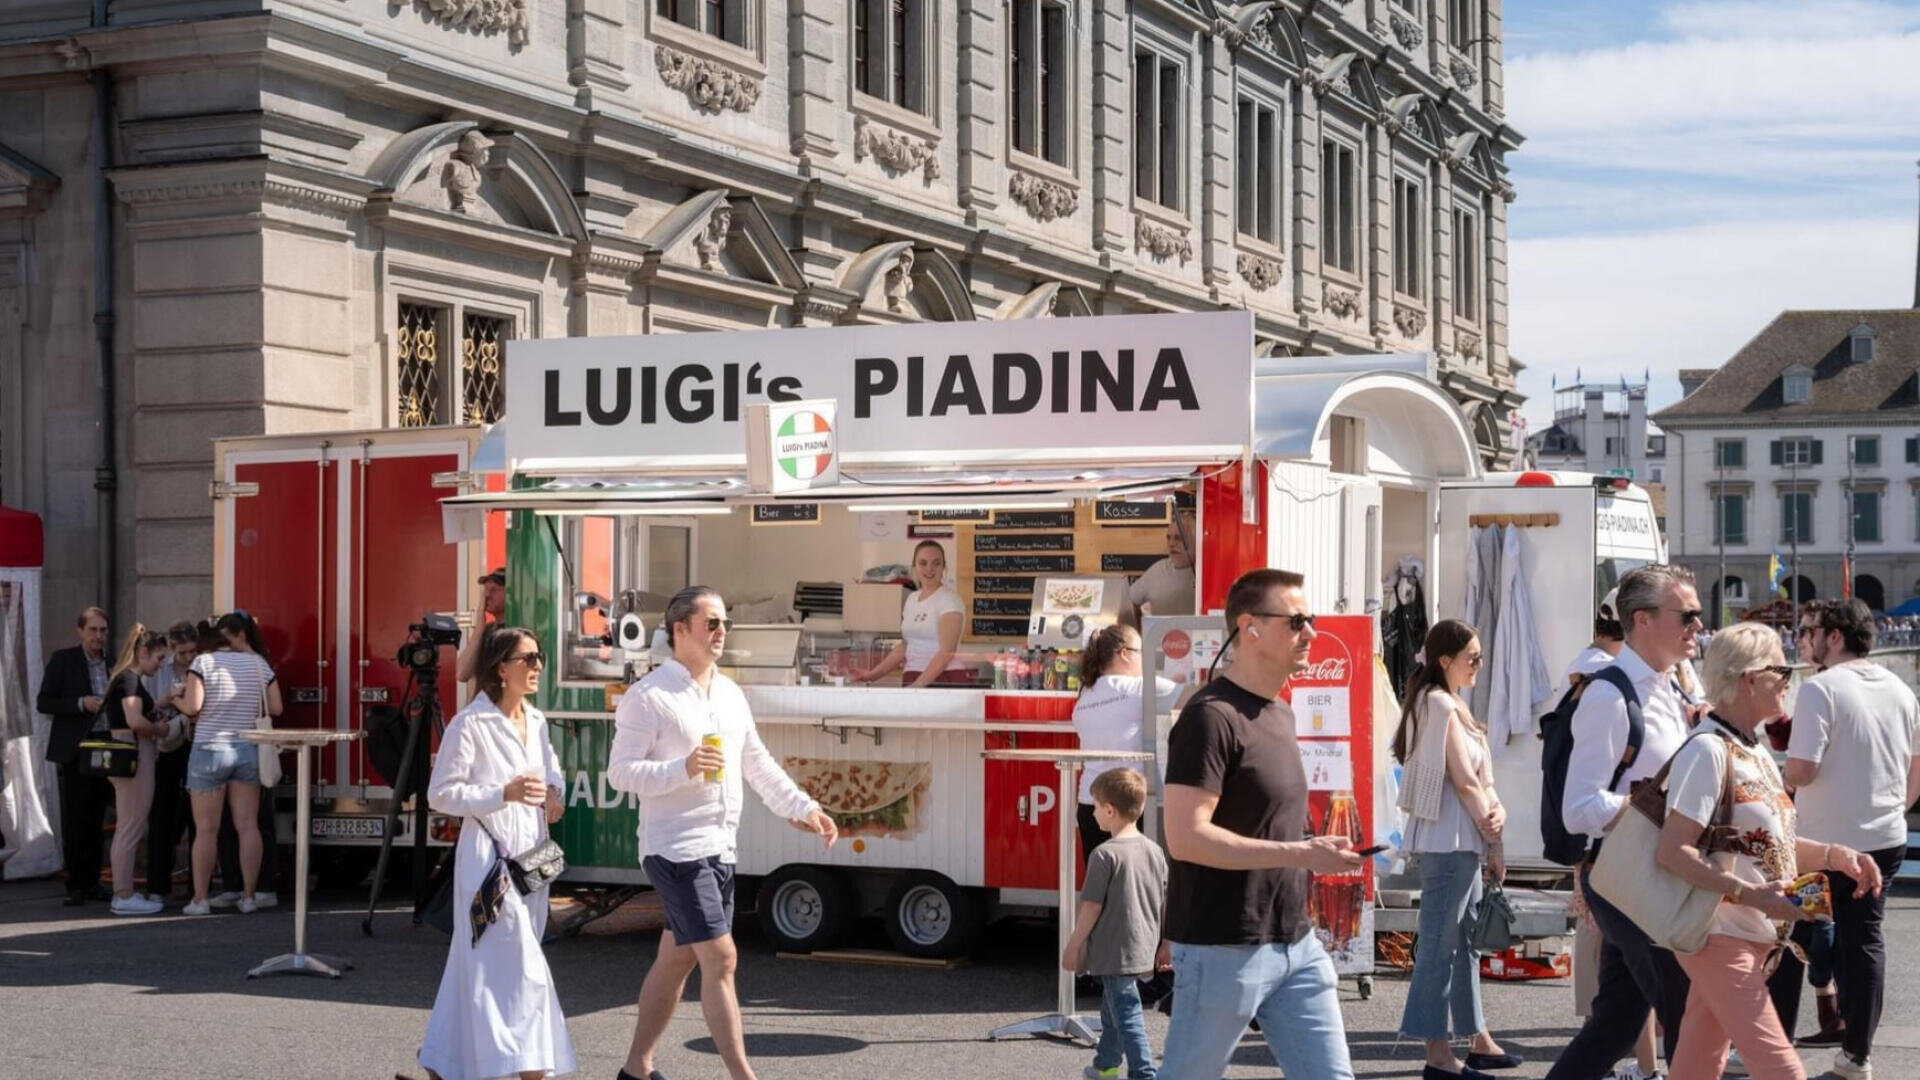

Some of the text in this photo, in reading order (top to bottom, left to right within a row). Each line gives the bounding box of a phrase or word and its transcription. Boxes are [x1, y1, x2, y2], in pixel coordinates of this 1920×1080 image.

[854, 347, 1200, 419] PIADINA
[804, 439, 828, 451] PIADINA
[1103, 503, 1141, 518] Kasse
[1307, 694, 1332, 706] BIER
